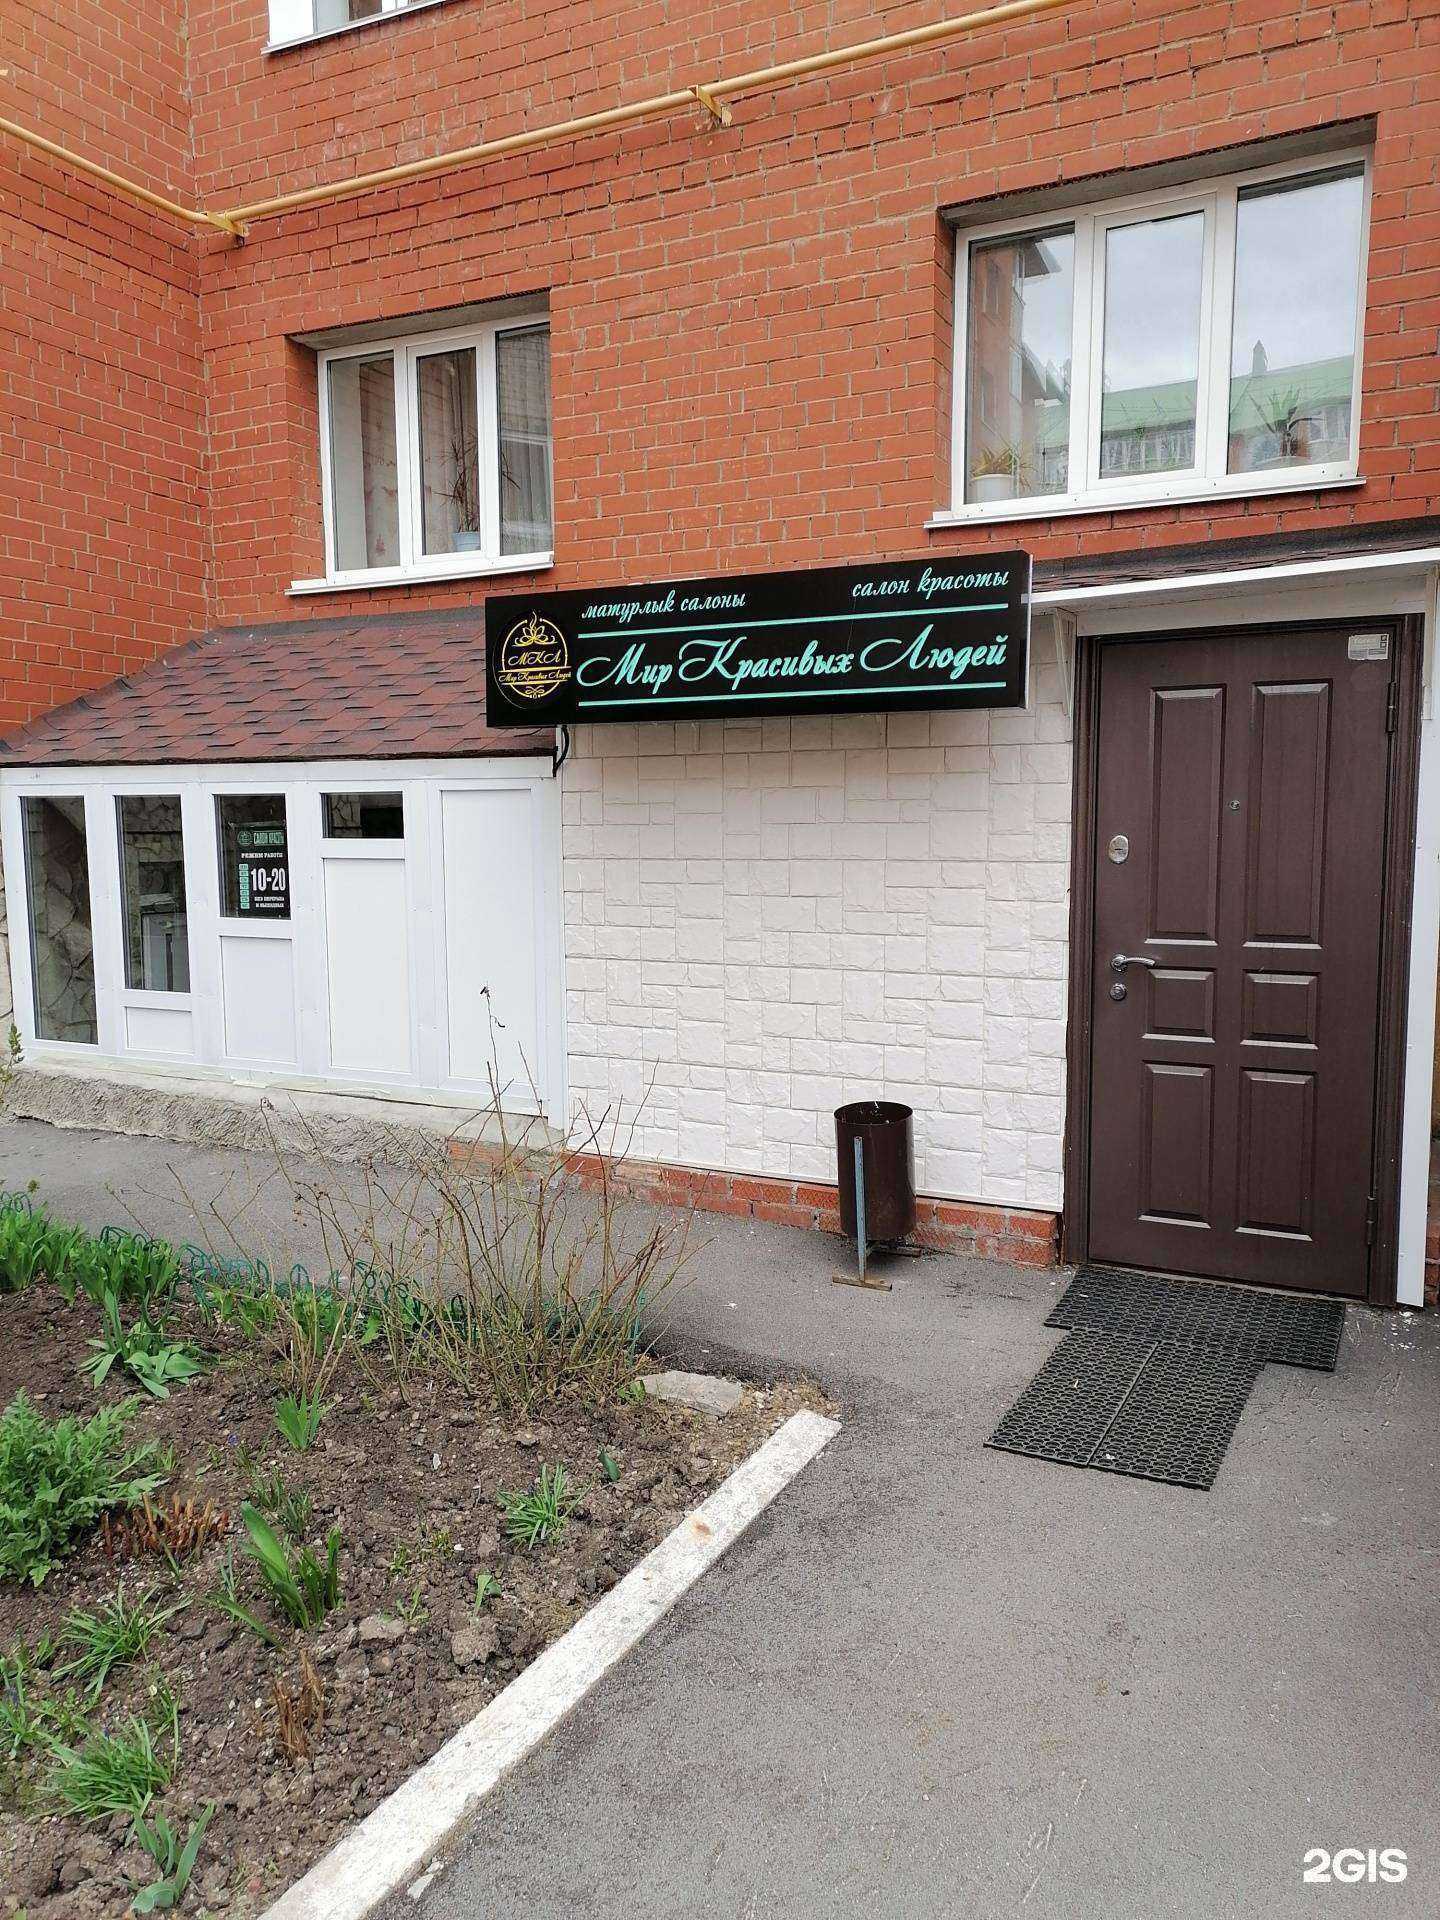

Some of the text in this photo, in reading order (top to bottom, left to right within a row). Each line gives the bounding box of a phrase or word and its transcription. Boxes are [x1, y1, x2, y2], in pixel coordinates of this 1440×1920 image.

[852, 567, 1009, 600] салон красоты
[582, 590, 746, 623] матурлык салоны
[576, 624, 1009, 694] Мир Красивых Людей
[251, 868, 286, 891] 10-20
